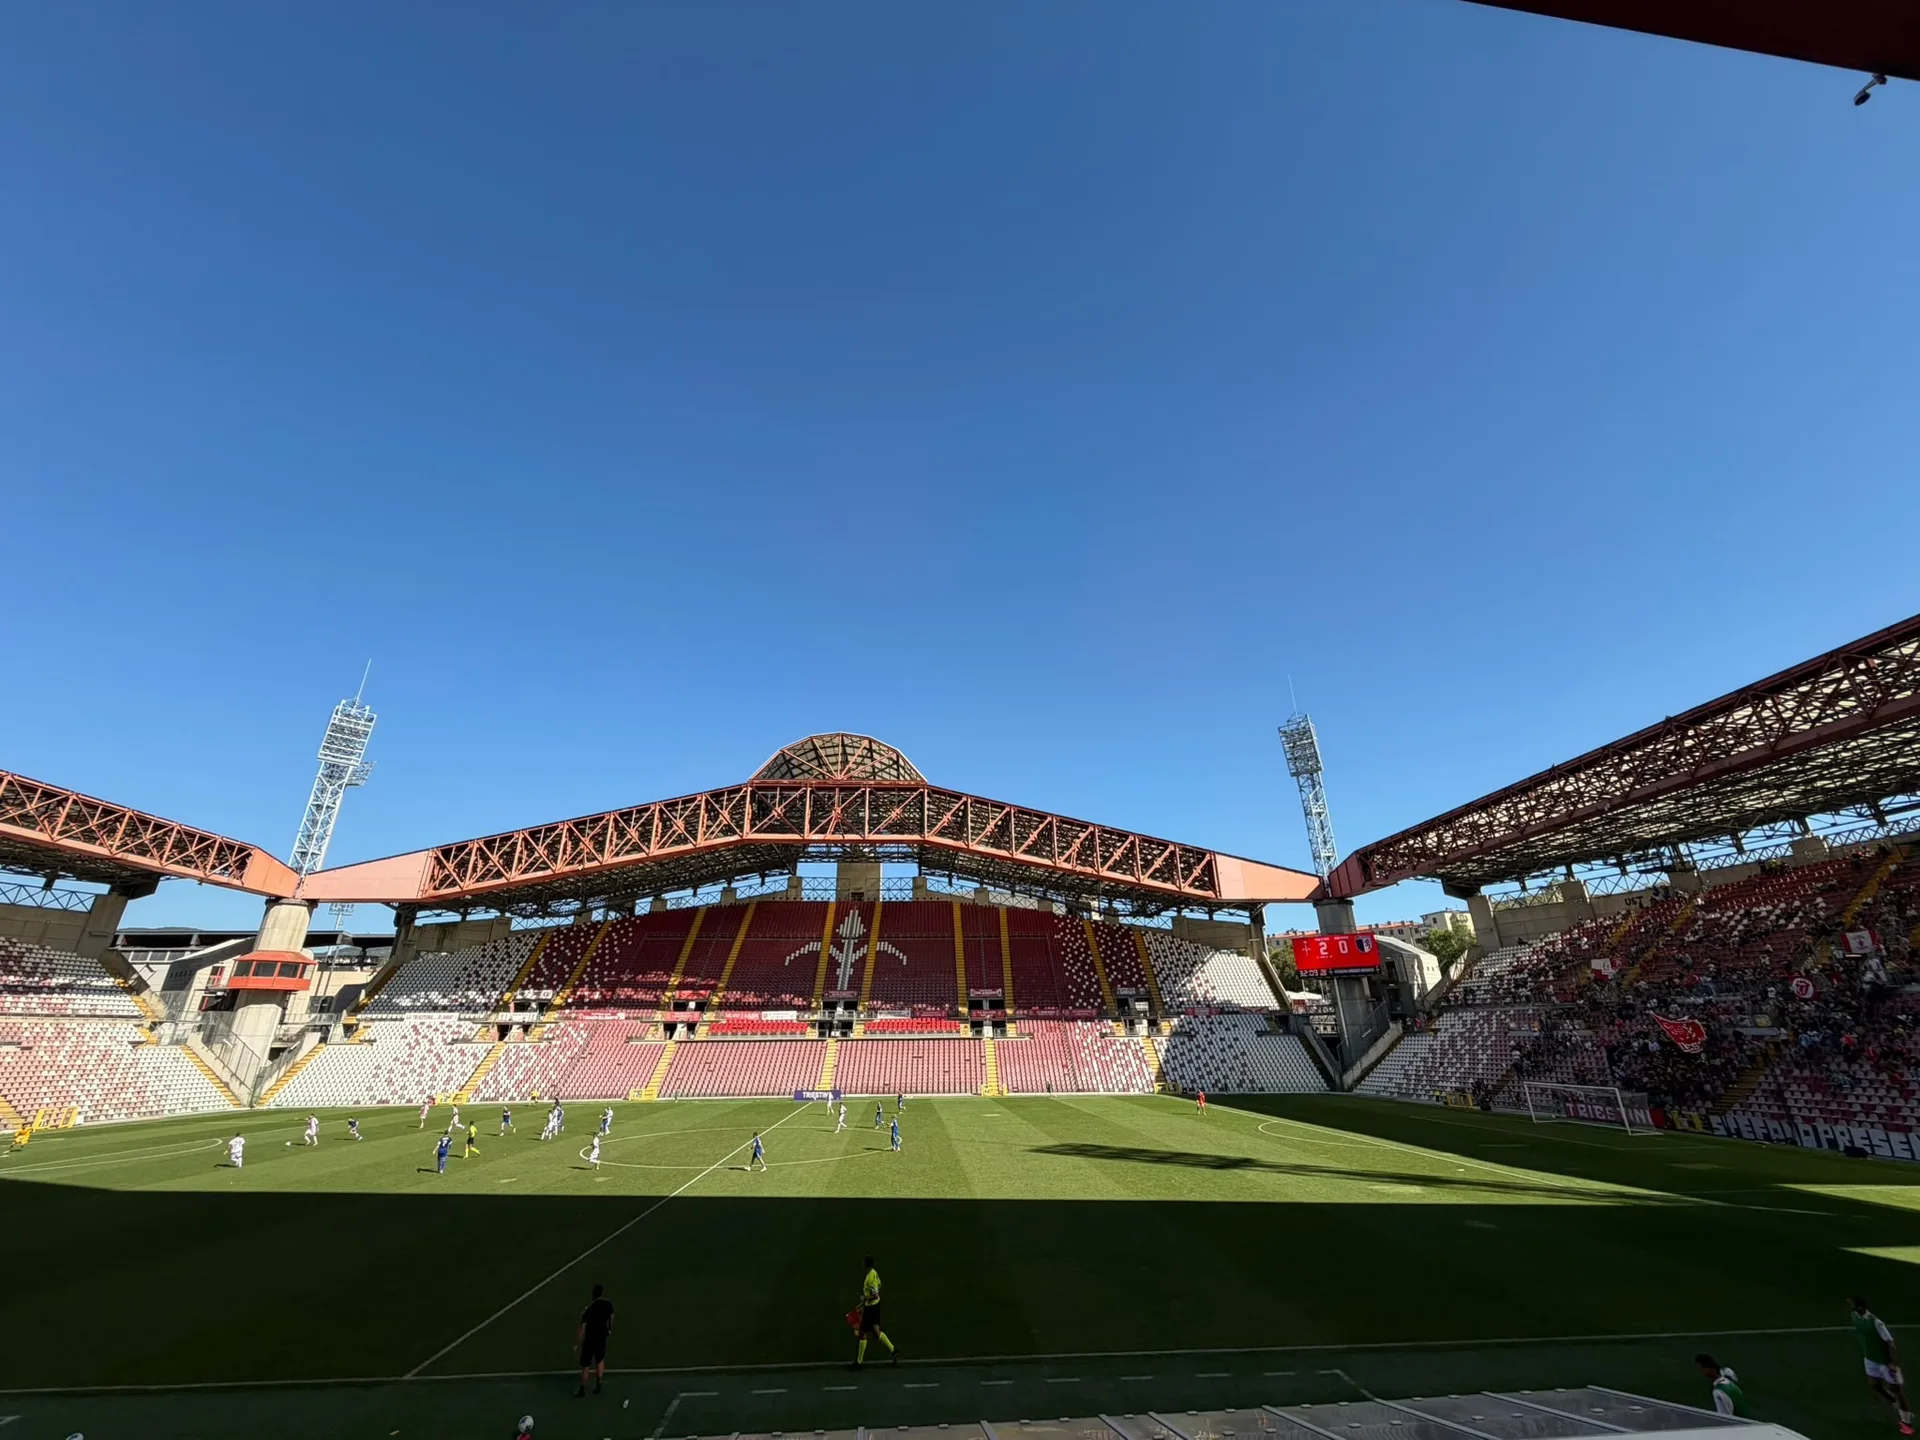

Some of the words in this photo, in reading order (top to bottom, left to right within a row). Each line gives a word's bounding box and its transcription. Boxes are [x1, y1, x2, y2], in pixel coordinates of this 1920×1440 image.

[1319, 941, 1328, 955] 2
[1338, 940, 1348, 954] 0
[802, 1091, 834, 1099] TRIESTIN
